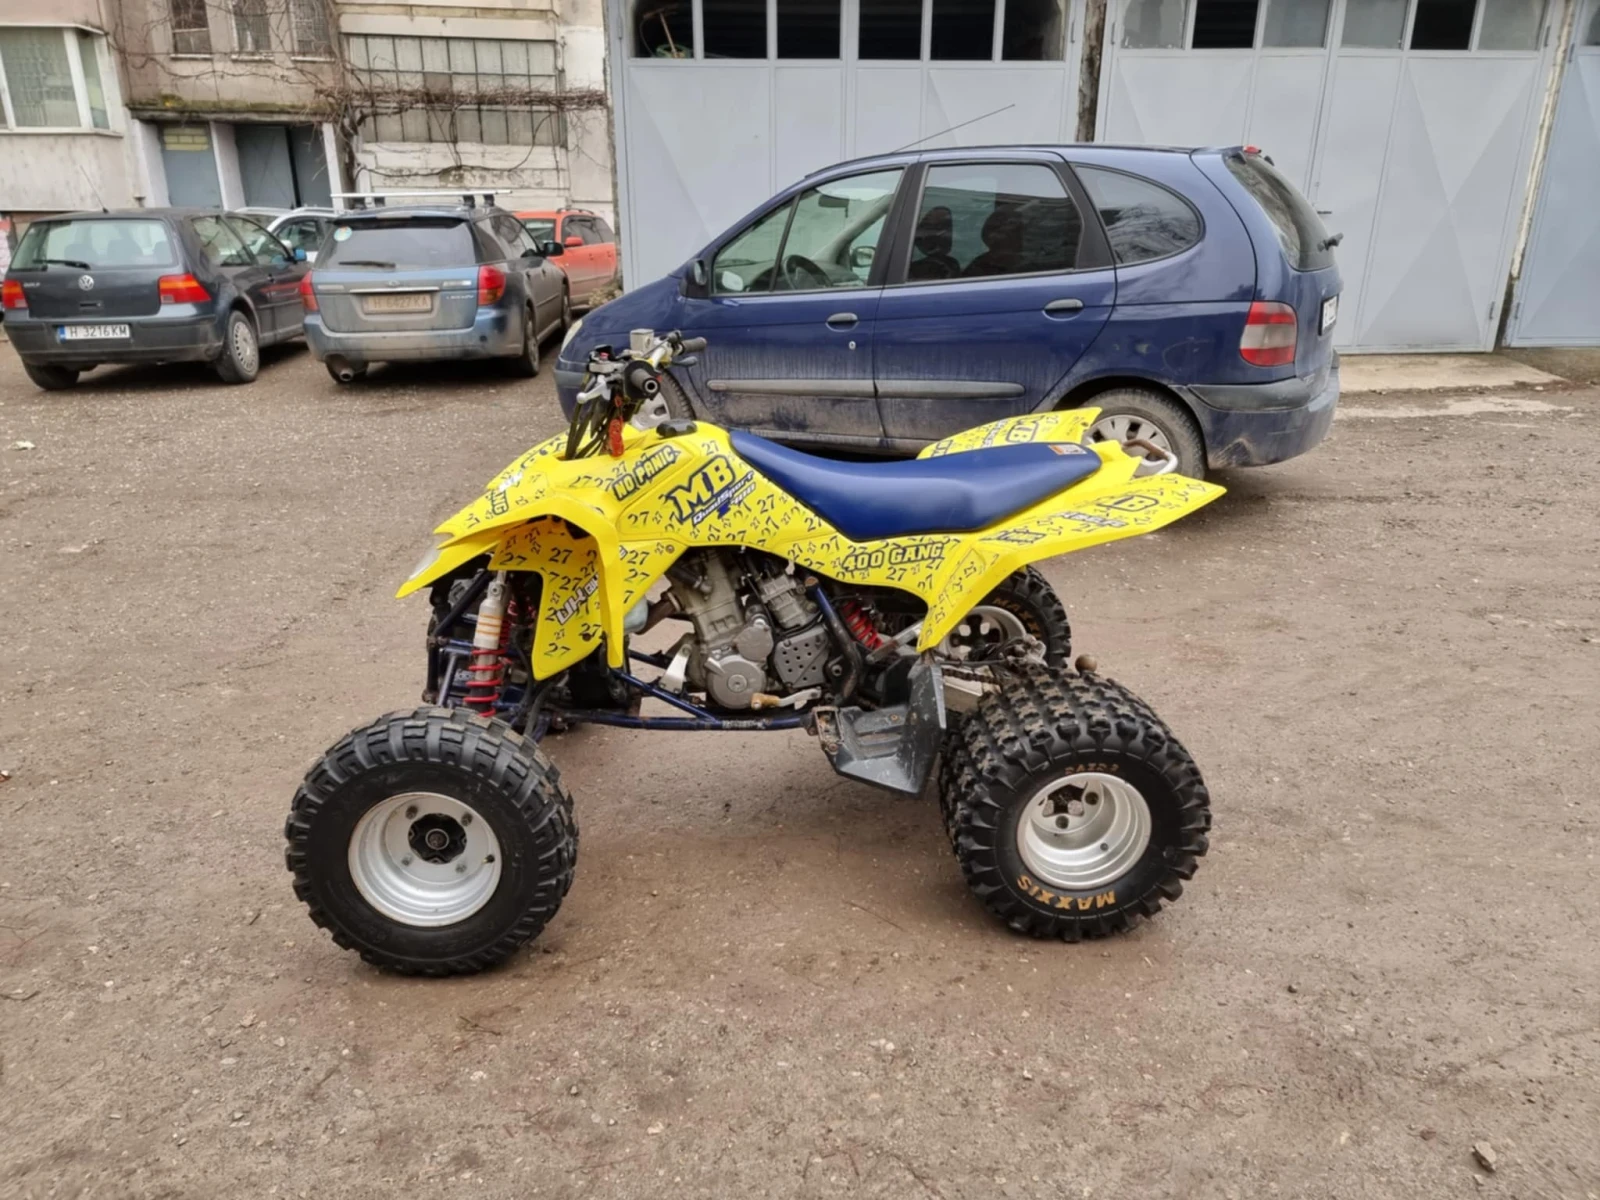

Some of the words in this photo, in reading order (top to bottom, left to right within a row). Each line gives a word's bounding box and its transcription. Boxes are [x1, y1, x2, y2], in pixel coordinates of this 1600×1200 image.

[701, 440, 719, 455] 27
[612, 474, 639, 501] NO
[633, 444, 679, 486] PANIC
[666, 454, 735, 524] MB
[757, 494, 775, 514] 27
[628, 511, 650, 526] 27
[761, 516, 780, 537] 27
[499, 552, 527, 565] 27
[549, 547, 573, 564] 27
[627, 550, 650, 566] 27
[841, 549, 885, 572] 400
[888, 541, 945, 565] GANG
[580, 561, 596, 578] 27
[624, 568, 650, 584] 27
[885, 567, 907, 581] 27
[559, 576, 583, 591] 27
[544, 643, 571, 656] 27
[1017, 875, 1116, 911] MAXXIS
